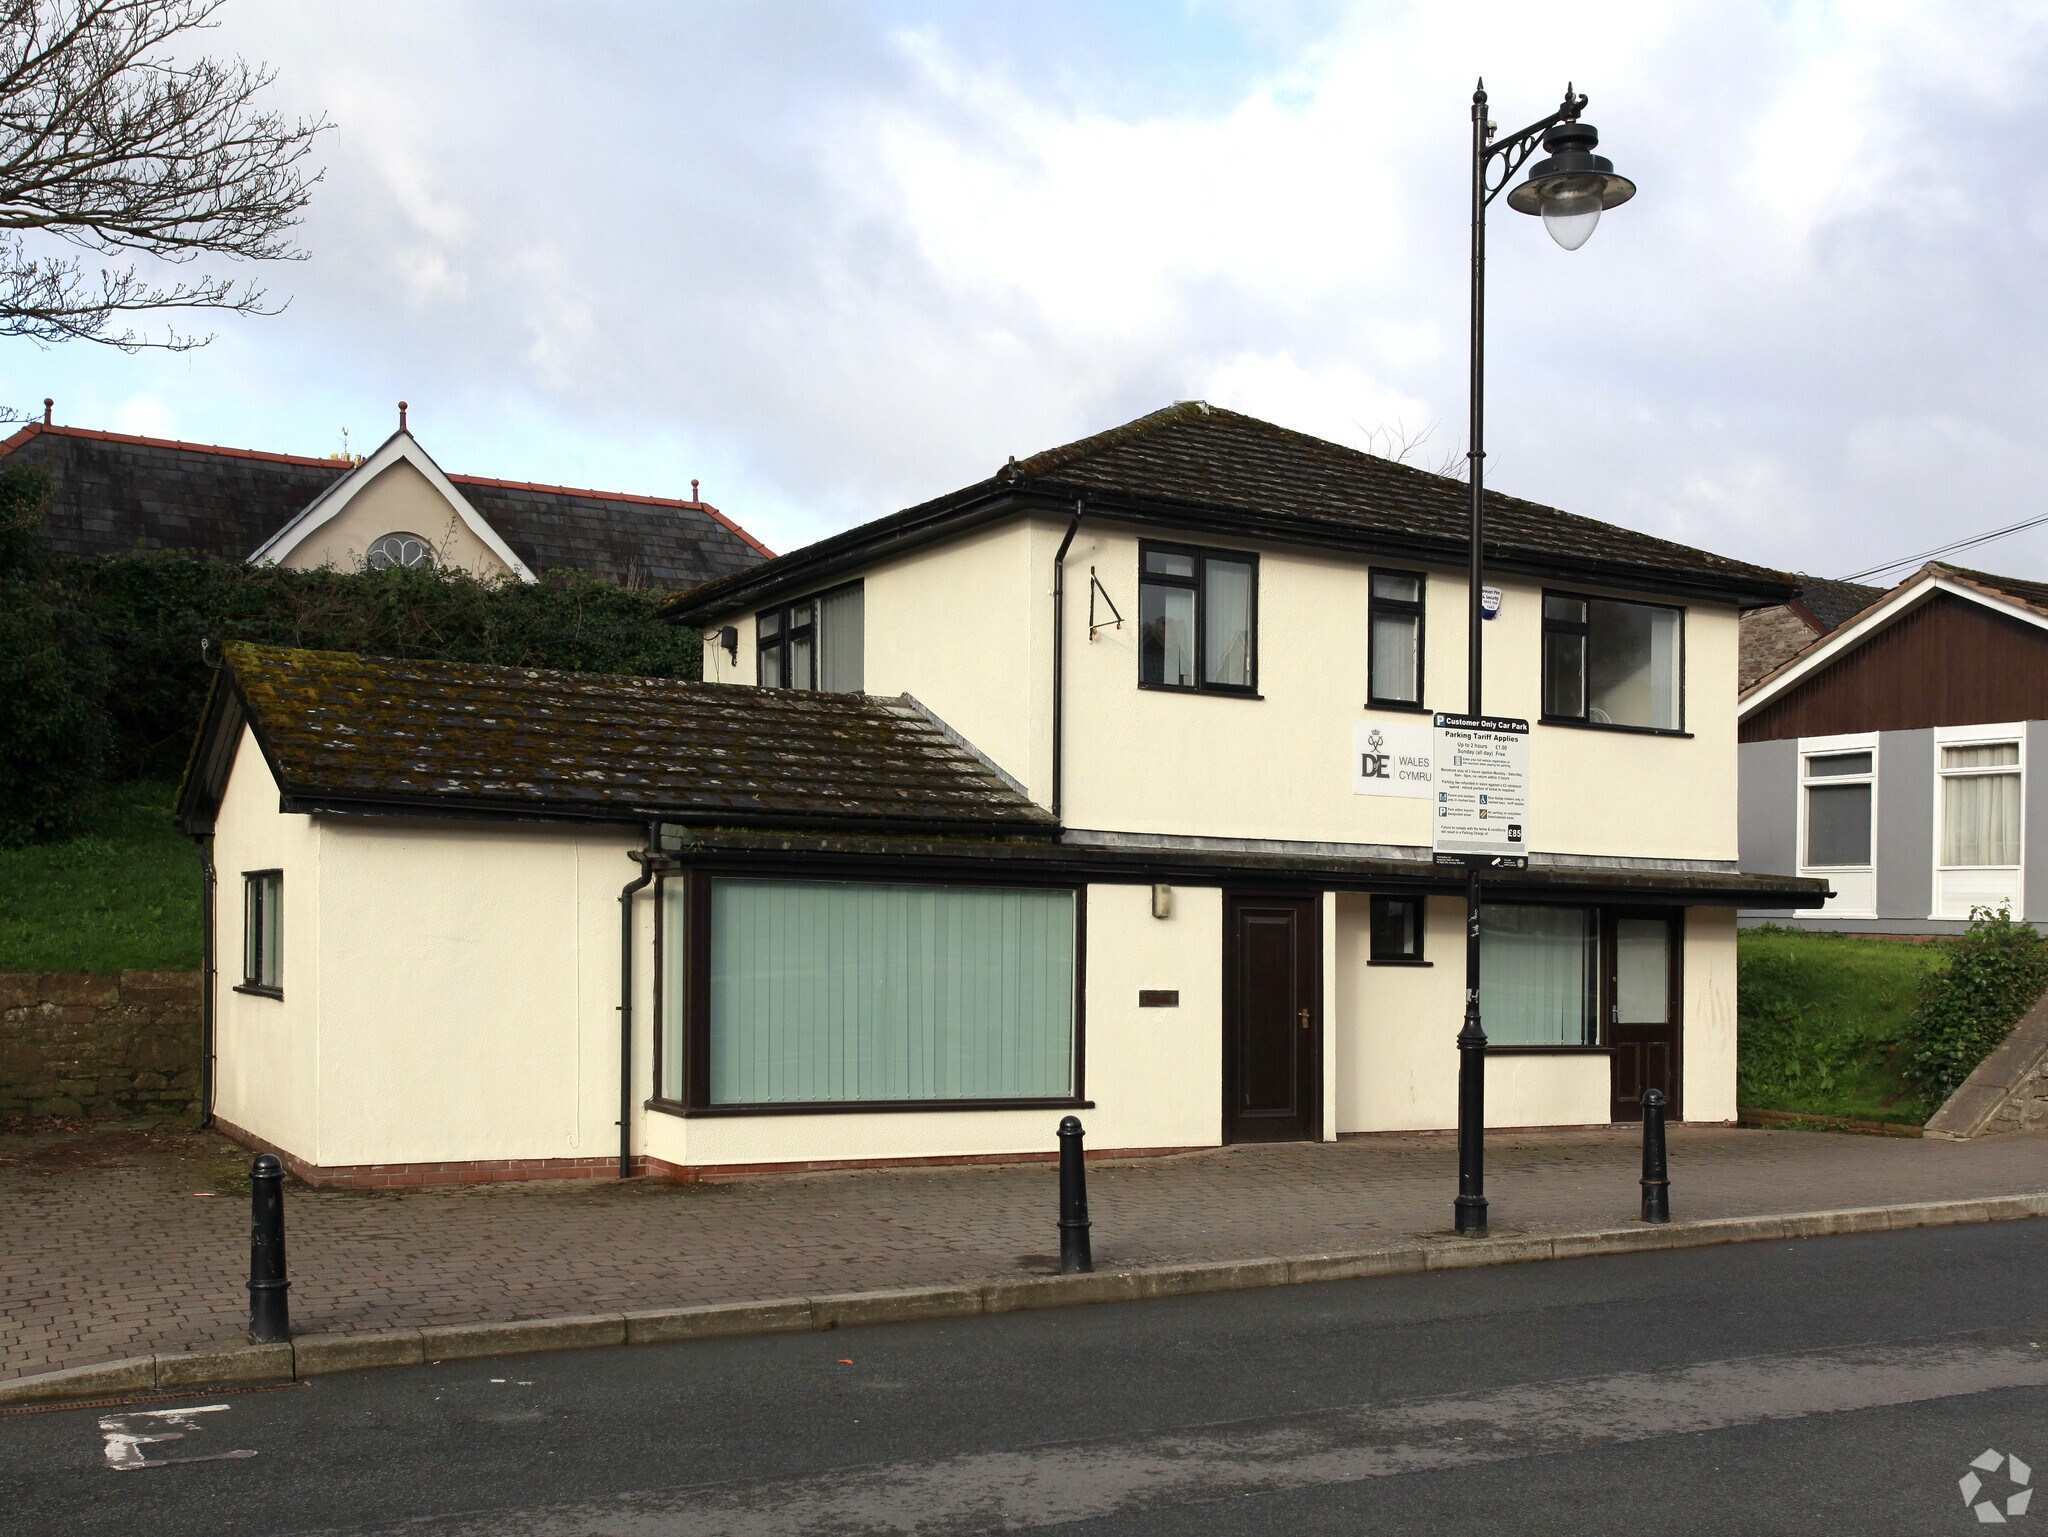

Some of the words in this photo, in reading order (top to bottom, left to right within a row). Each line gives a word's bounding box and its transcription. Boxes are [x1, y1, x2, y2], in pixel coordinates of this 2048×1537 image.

[1446, 718, 1479, 726] Customer
[1481, 720, 1497, 729] Only
[1445, 731, 1471, 740] Parking
[1494, 735, 1518, 743] Applies
[1399, 756, 1430, 767] WALES
[1399, 770, 1432, 781] CYMRU
[1509, 829, 1521, 837] £85
